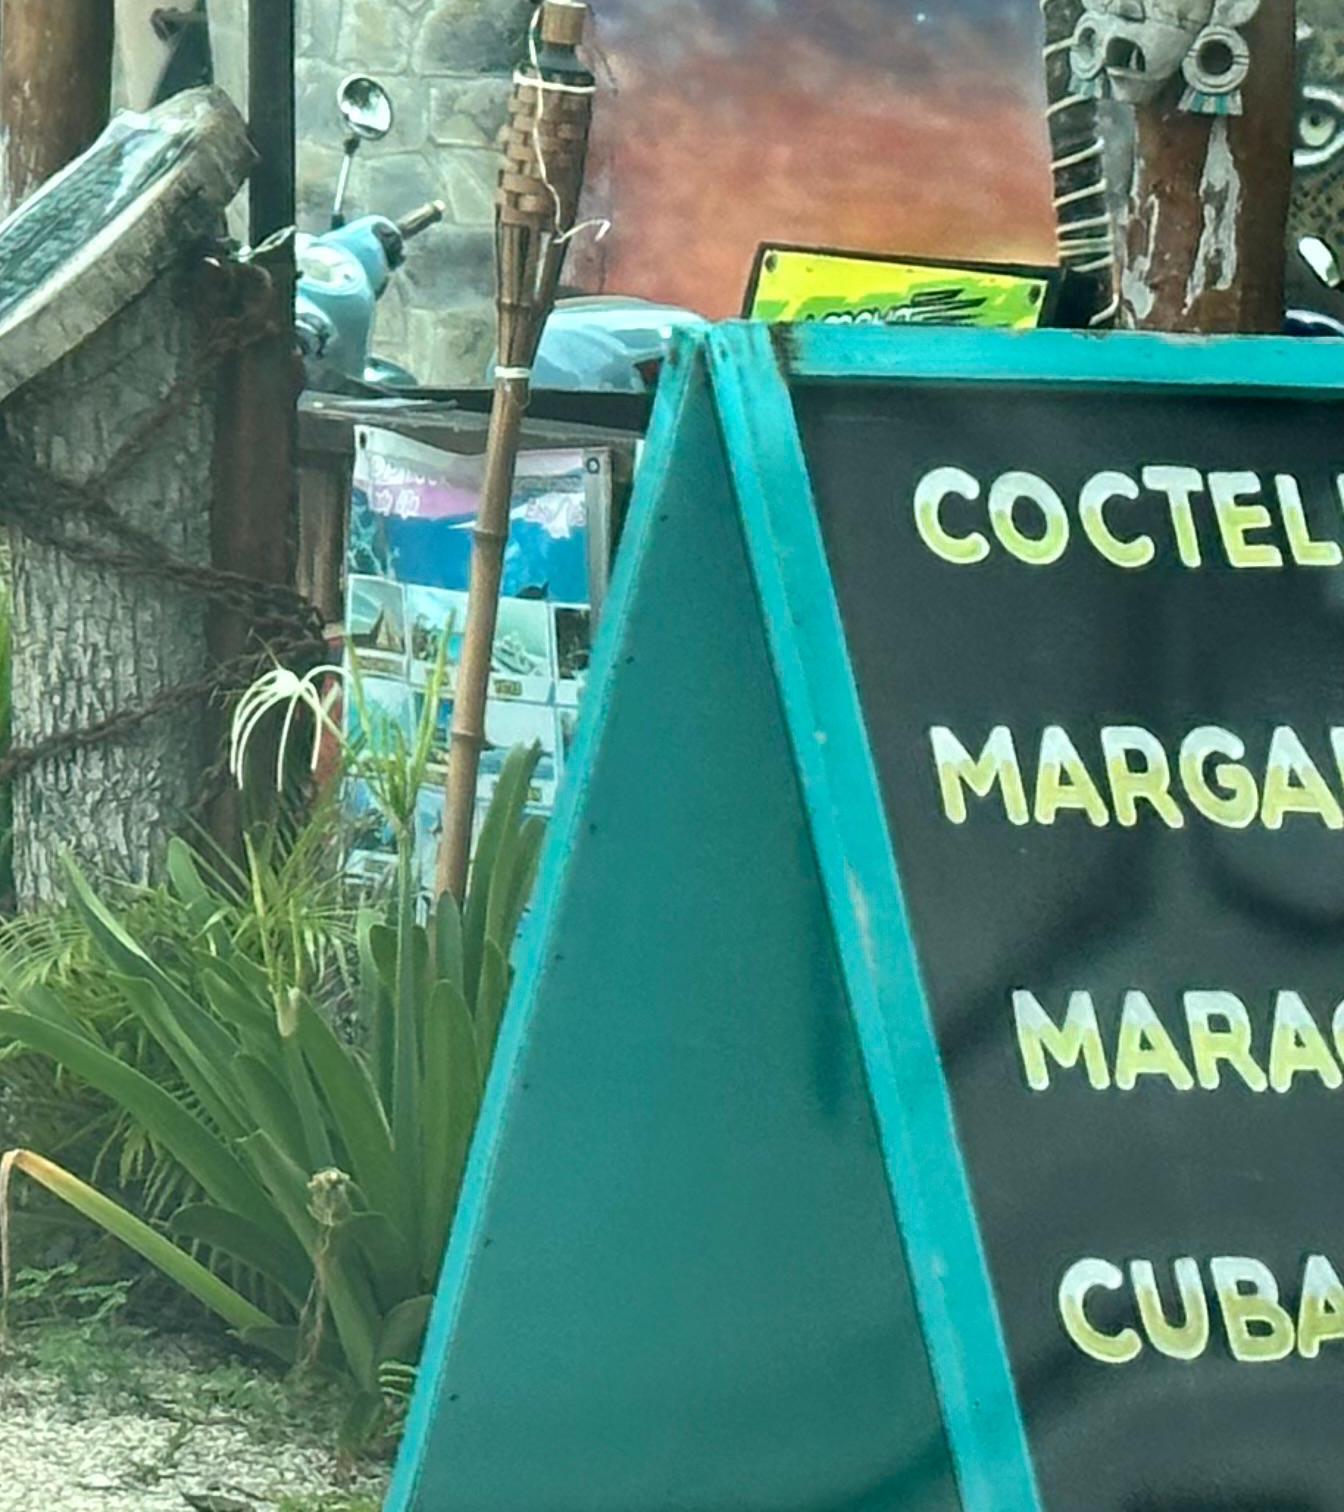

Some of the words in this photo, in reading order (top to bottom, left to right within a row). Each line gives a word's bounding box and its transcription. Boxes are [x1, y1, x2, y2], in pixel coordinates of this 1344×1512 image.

[914, 466, 1344, 568] COCTEL
[929, 725, 1344, 830] MARGA
[1012, 989, 1344, 1092] MARA
[1058, 1254, 1344, 1363] CUBA
